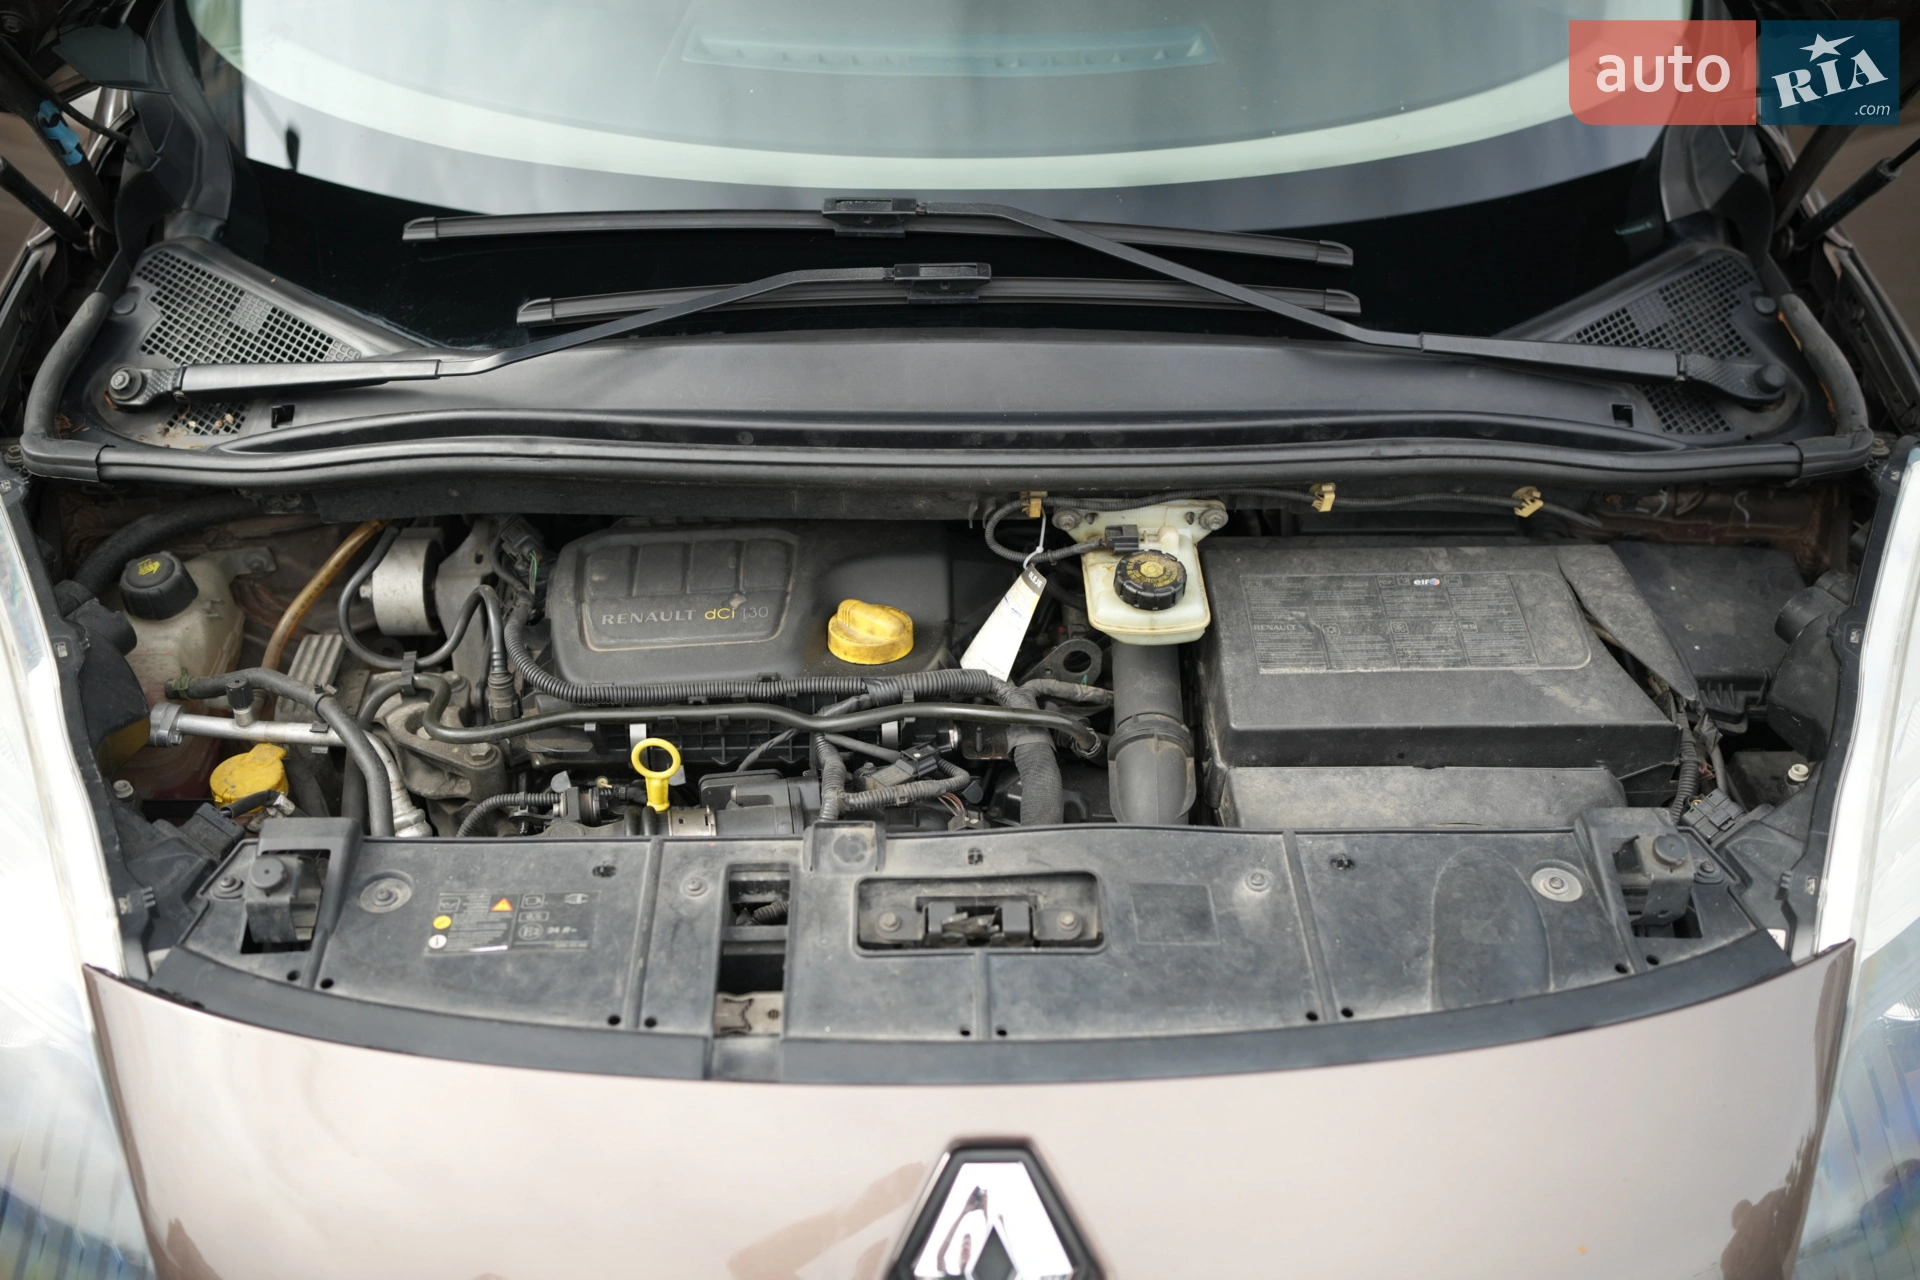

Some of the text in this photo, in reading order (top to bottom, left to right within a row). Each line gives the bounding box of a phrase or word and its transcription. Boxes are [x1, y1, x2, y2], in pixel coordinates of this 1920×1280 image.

[1028, 571, 1043, 588] OLEJE
[1413, 577, 1430, 586] elf
[601, 609, 697, 625] RENAULT
